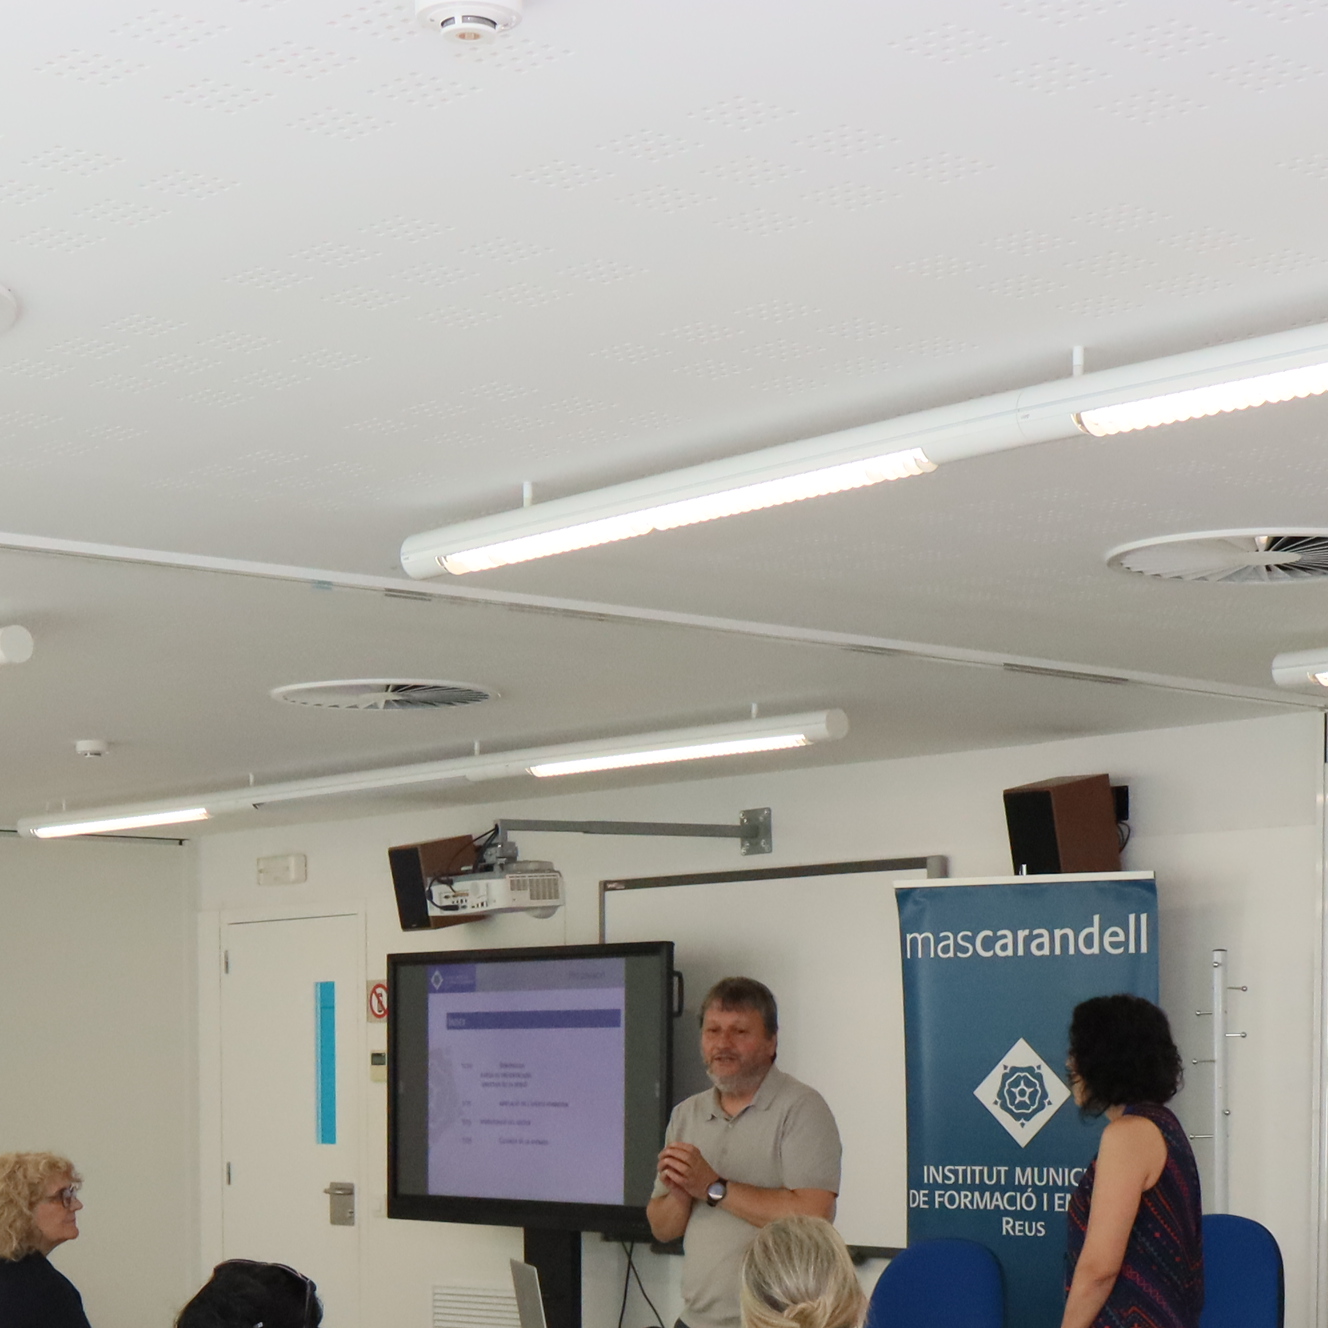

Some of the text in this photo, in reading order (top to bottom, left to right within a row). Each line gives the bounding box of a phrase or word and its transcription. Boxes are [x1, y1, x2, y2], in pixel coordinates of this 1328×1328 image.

[906, 913, 1148, 959] mascarandell
[923, 1165, 1088, 1187] INSTITUT MUNIC
[909, 1189, 929, 1209] DE
[934, 1187, 1037, 1211] FORMACIÓ
[1042, 1193, 1048, 1212] I
[1001, 1217, 1046, 1237] REUS
